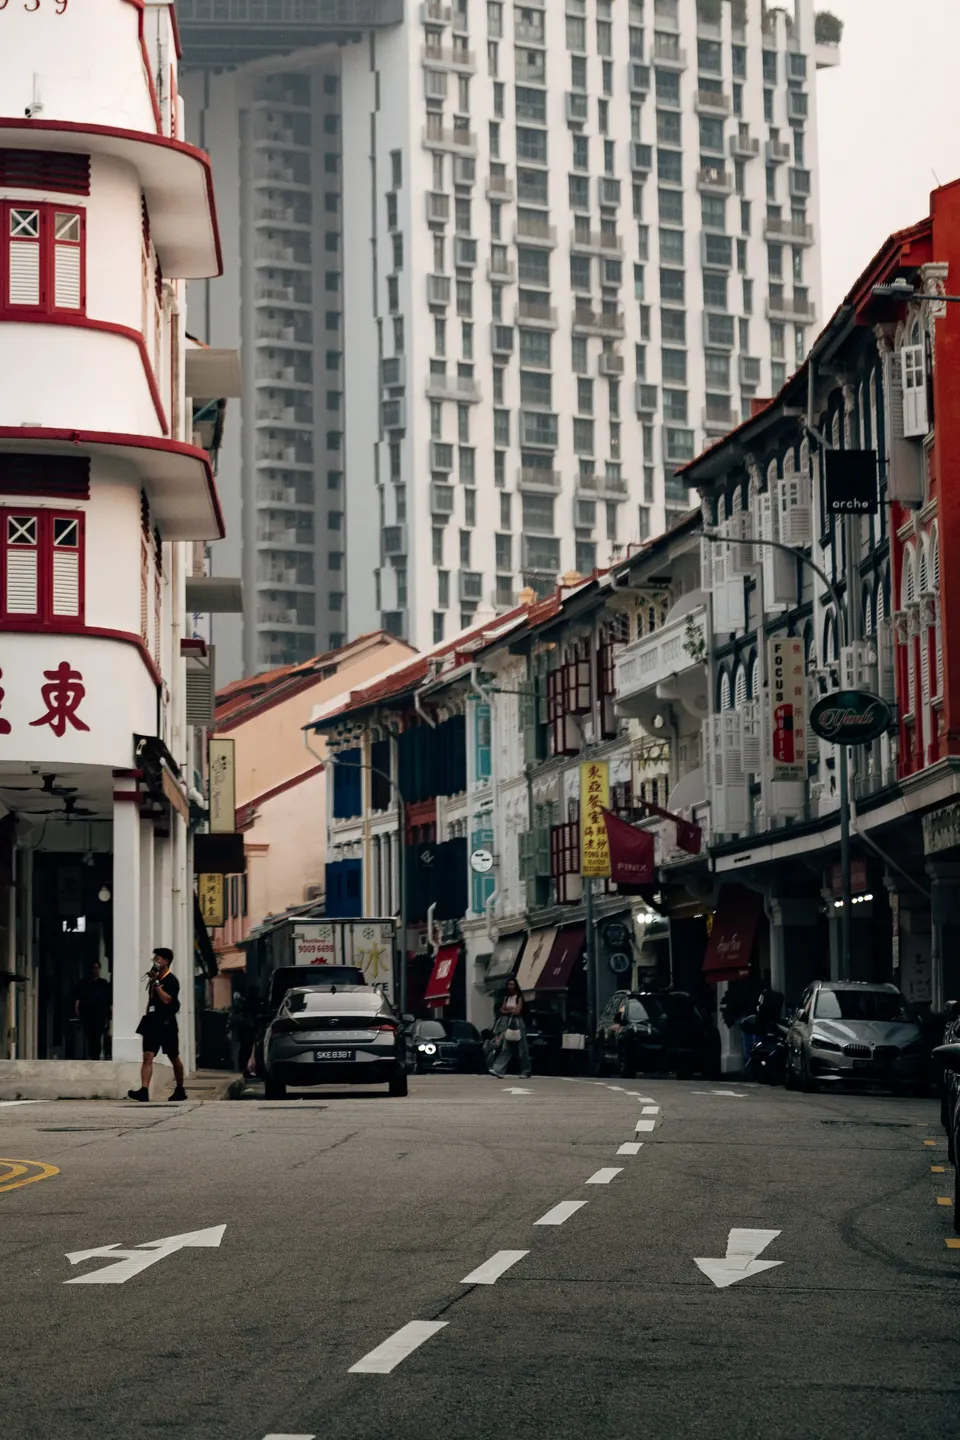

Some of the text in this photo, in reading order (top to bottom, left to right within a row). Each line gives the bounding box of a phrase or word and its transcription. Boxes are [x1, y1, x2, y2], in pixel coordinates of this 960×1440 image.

[832, 498, 869, 509] arche
[774, 643, 785, 760] FOCUS MUSIC
